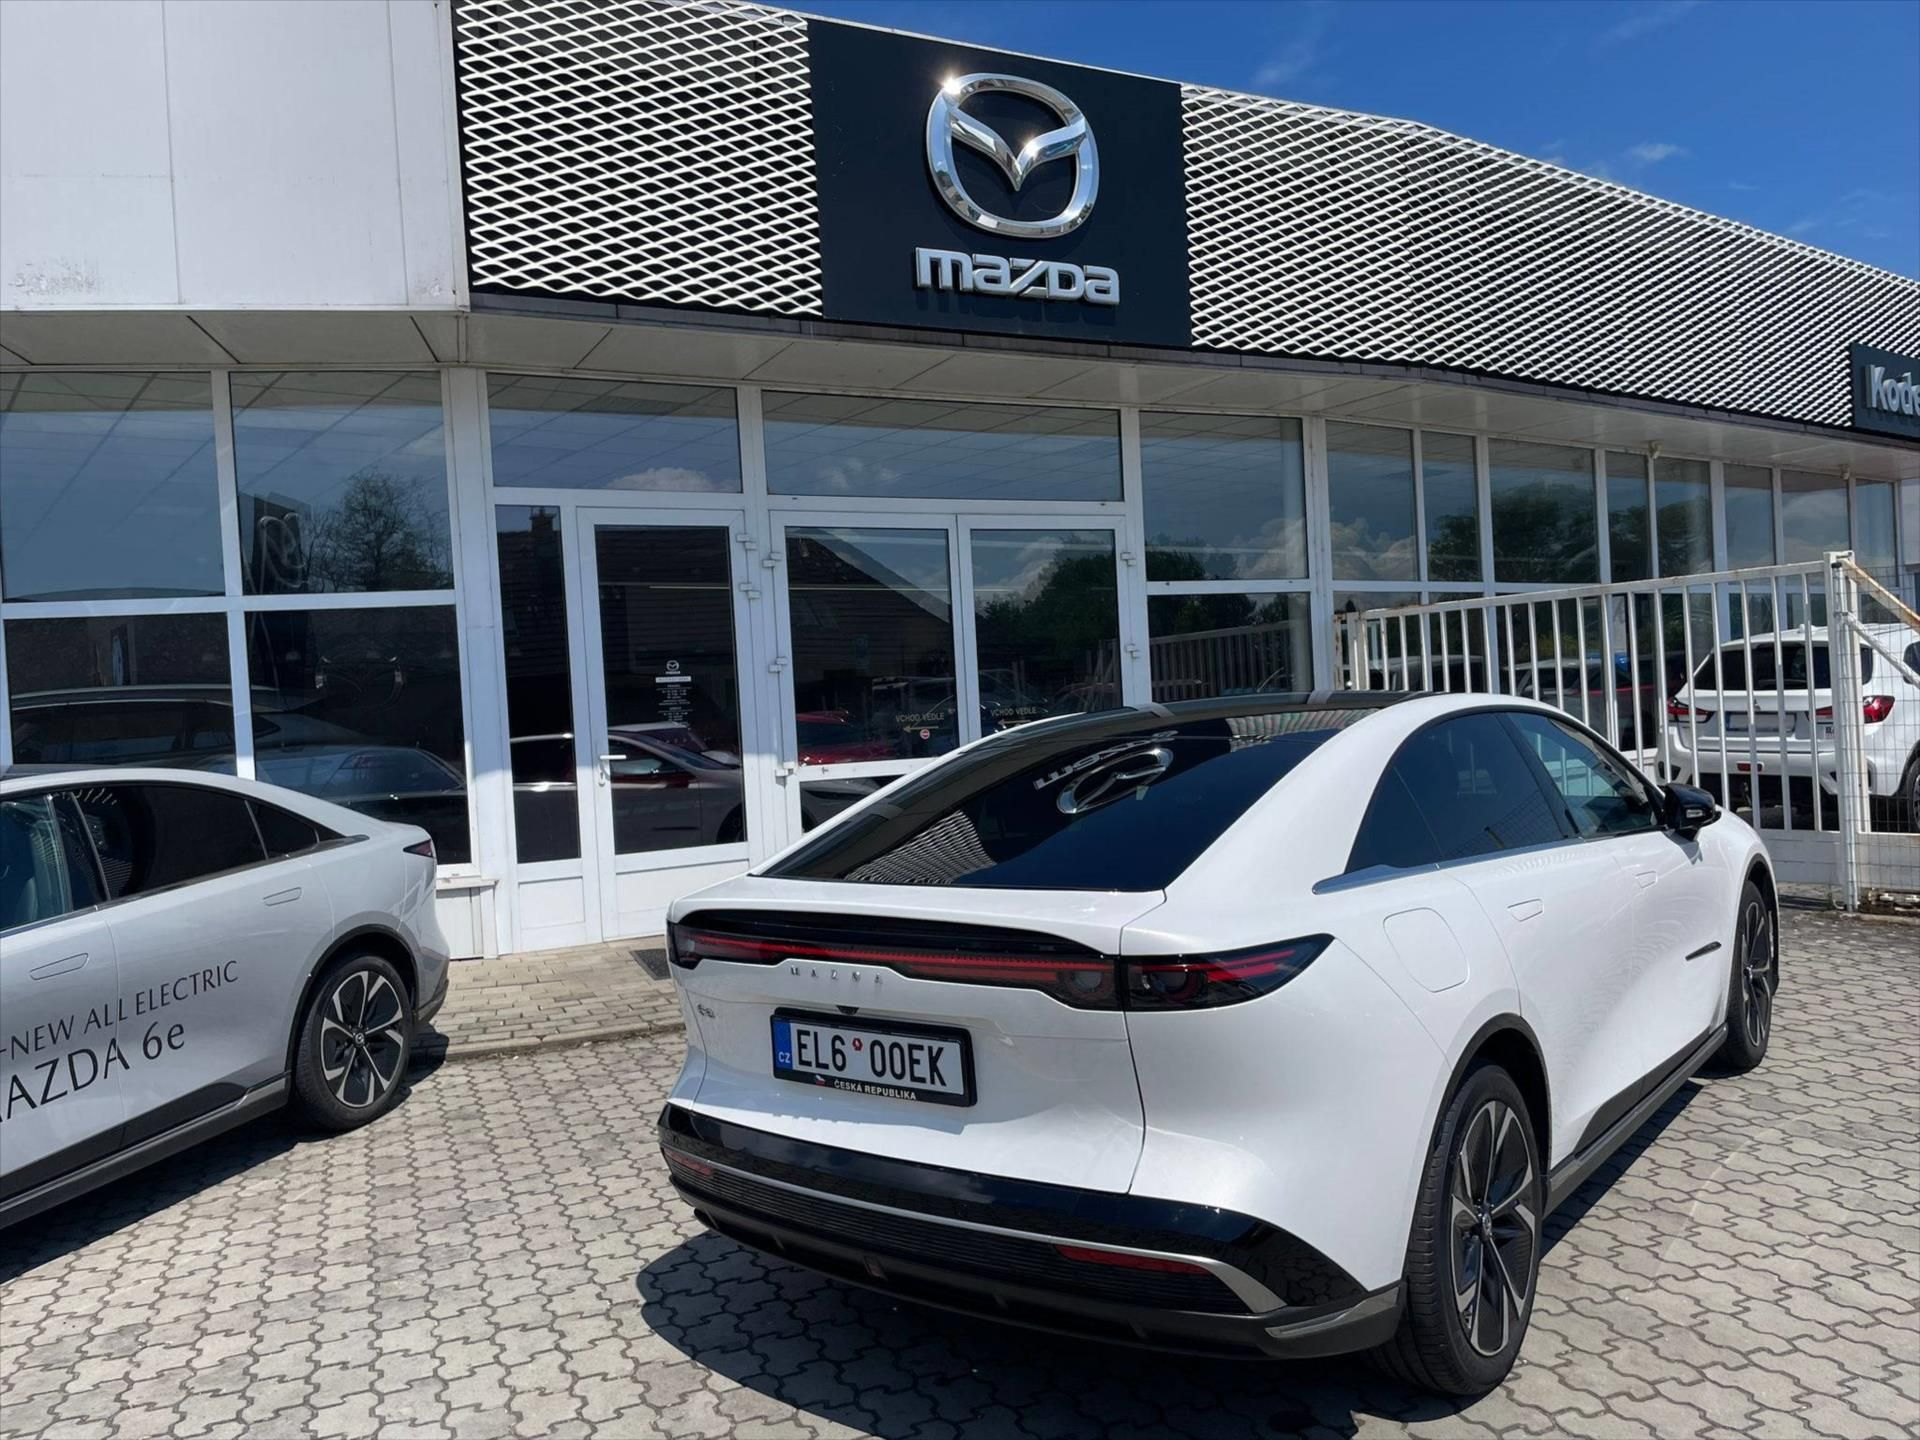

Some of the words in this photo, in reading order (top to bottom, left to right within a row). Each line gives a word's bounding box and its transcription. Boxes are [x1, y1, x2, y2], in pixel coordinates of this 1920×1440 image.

[915, 247, 1120, 305] mazda
[84, 998, 129, 1034] ALL
[135, 960, 239, 1016] ELECTRIC
[0, 1038, 130, 1123] AZDA
[142, 1021, 185, 1060] 6e
[778, 1050, 791, 1064] CZ
[796, 1029, 847, 1072] EL6
[869, 1039, 947, 1087] 00EK
[834, 1079, 863, 1092] ČESKÁ
[864, 1085, 917, 1100] REPUBLIKA
